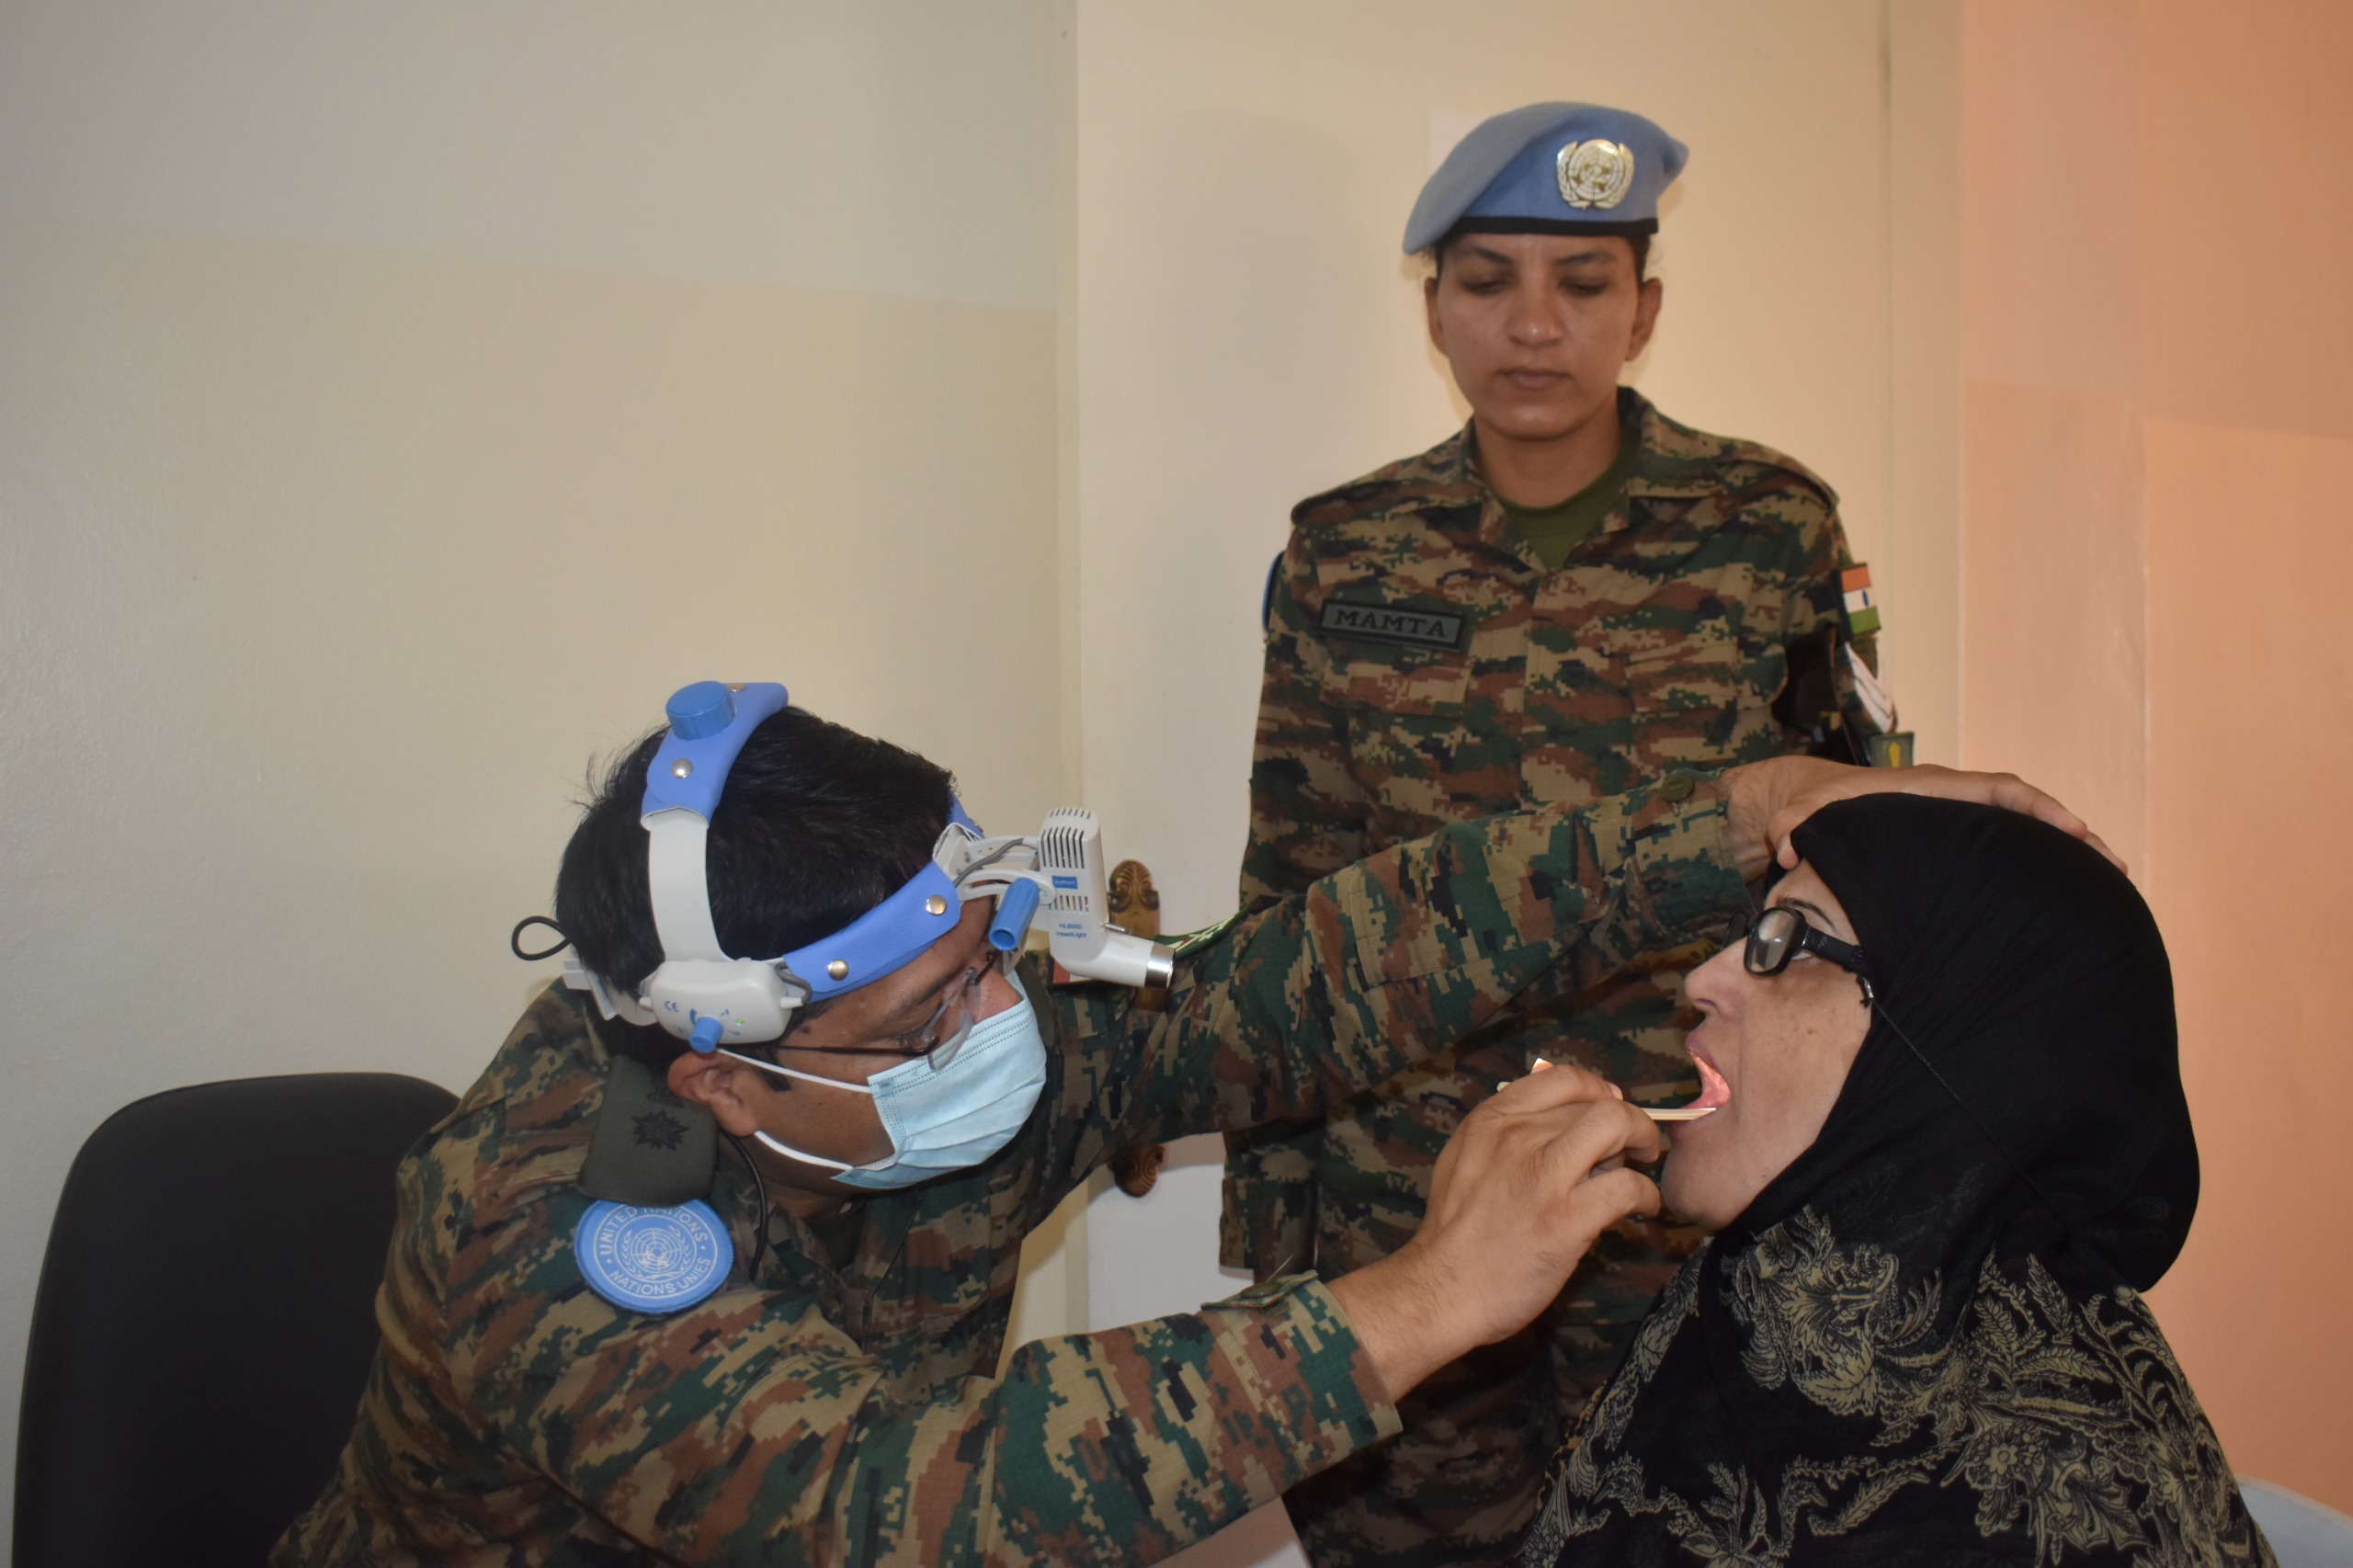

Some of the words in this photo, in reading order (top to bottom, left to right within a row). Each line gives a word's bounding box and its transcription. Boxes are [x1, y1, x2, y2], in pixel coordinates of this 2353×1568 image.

[1335, 609, 1446, 638] MAMTA
[600, 1206, 637, 1256] UNITED
[609, 1270, 676, 1295] NATIONS
[678, 1257, 710, 1288] UNIES
